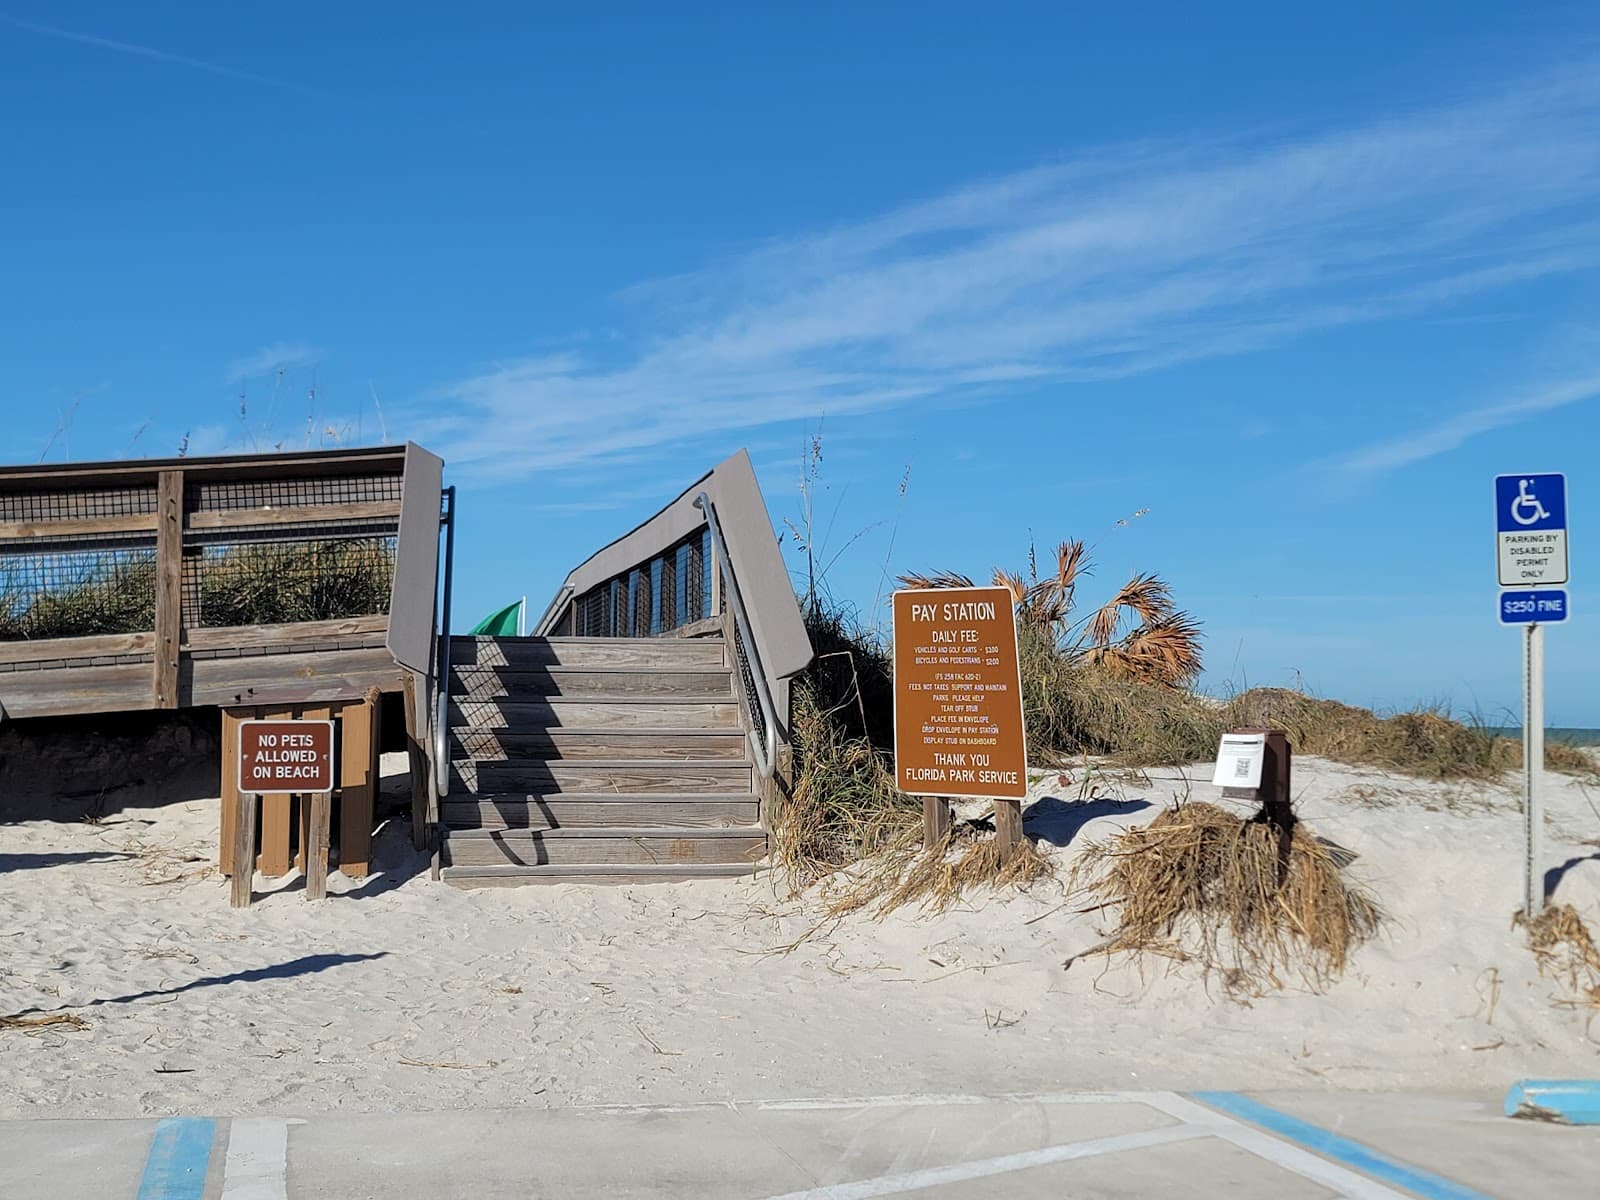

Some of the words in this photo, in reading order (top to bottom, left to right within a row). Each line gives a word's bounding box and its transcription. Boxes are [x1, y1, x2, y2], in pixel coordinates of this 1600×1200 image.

[1505, 535, 1544, 543] PARKING
[1545, 534, 1558, 542] BY
[1510, 547, 1554, 555] DISABLED
[1516, 558, 1548, 566] PERMIT
[1520, 570, 1544, 578] ONLY
[912, 604, 937, 622] PAY
[944, 602, 995, 621] STATION
[1504, 601, 1535, 614] $250
[1537, 600, 1562, 611] FINE
[932, 630, 957, 643] DAILY
[961, 630, 979, 642] FEE:
[916, 657, 937, 665] BICYCLES
[923, 683, 932, 691] NOT
[952, 683, 972, 691] SUPPORT
[259, 735, 277, 747] NO
[281, 735, 313, 747] PETS
[945, 737, 957, 745] STUB
[256, 750, 317, 762] ALLOWED
[934, 753, 965, 766] THANK
[970, 754, 989, 766] YOU
[253, 766, 270, 778] ON
[276, 766, 319, 778] BEACH
[906, 768, 946, 781] FLORIDA
[950, 769, 975, 782] PARK
[979, 771, 1018, 784] SERVICE
